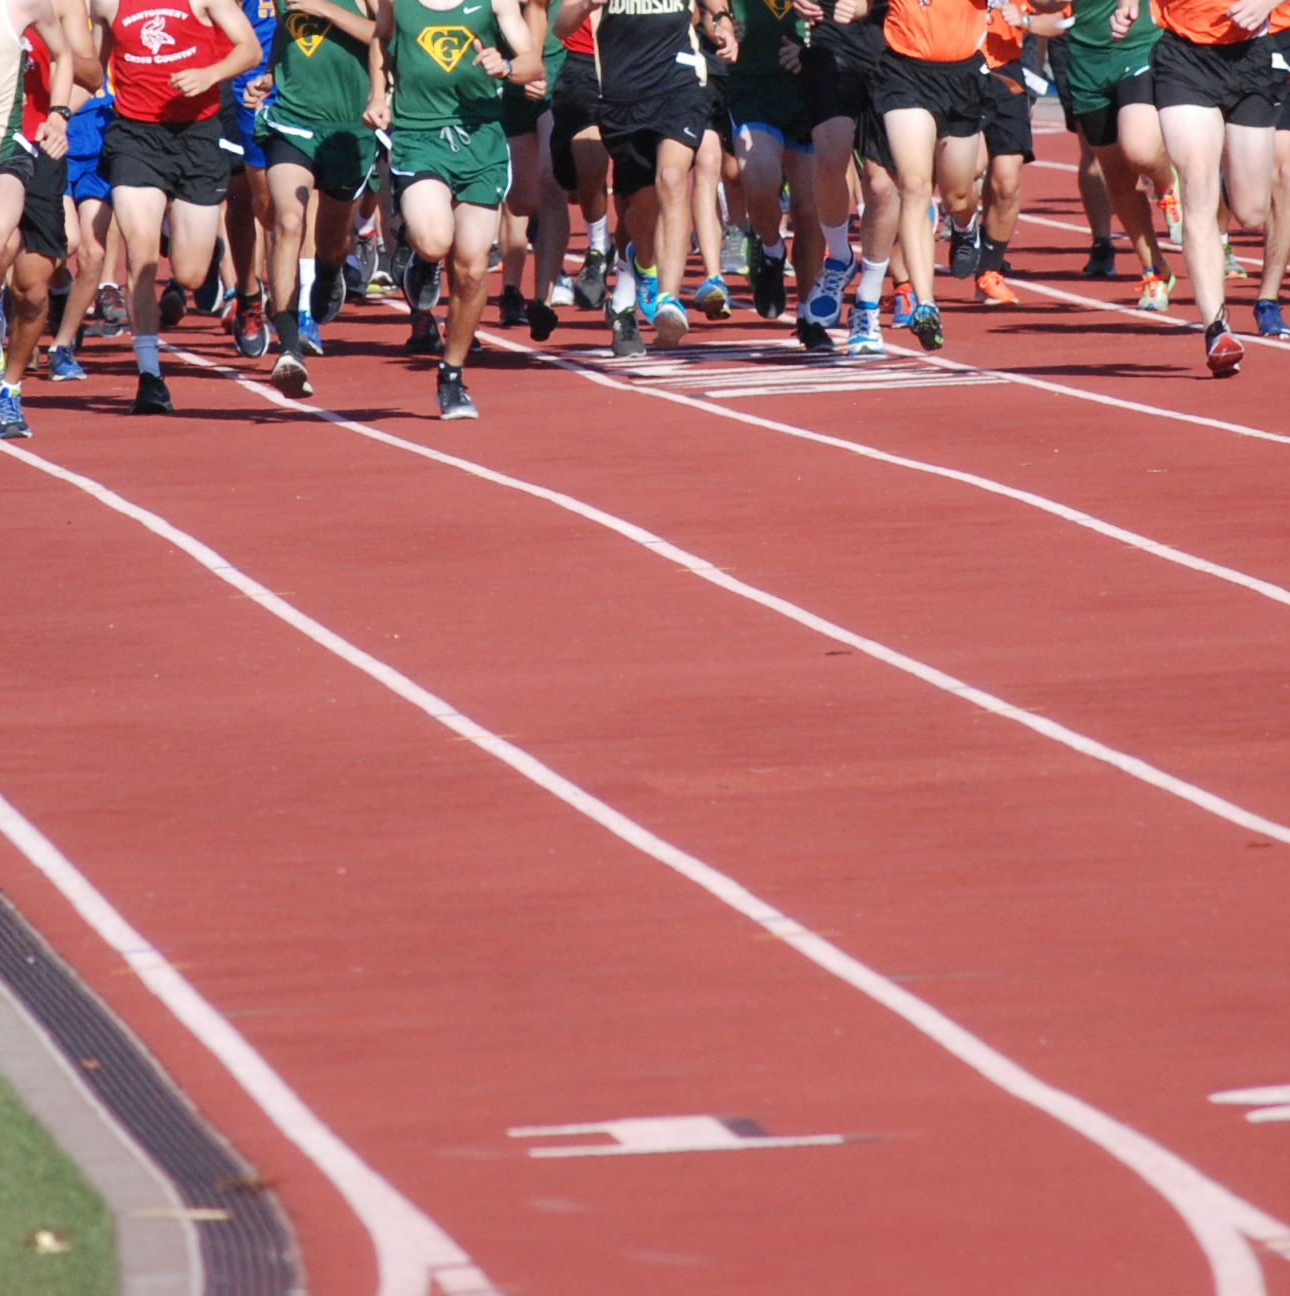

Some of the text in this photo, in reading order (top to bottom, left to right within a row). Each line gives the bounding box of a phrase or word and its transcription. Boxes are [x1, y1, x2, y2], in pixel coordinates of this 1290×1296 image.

[122, 8, 188, 27] MONTGOMERY
[124, 46, 197, 64] CROSS COUNTRY
[507, 1115, 843, 1157] 1
